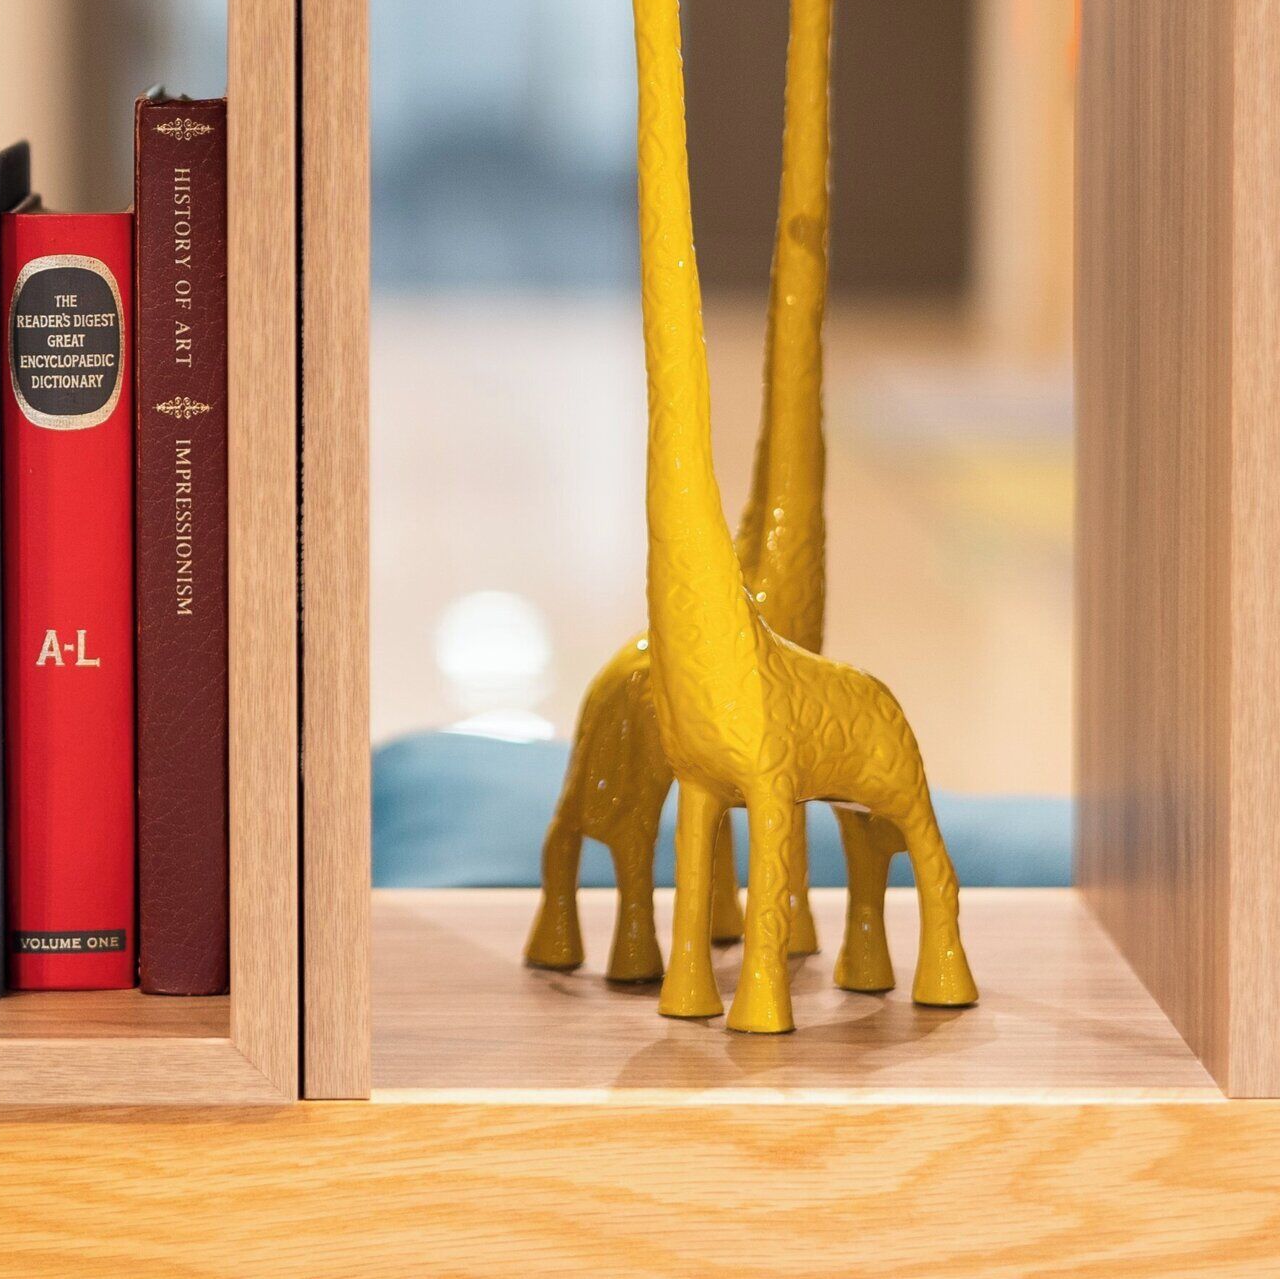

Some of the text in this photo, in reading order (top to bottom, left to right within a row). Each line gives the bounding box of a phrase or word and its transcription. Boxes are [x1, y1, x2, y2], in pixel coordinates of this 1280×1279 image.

[174, 168, 193, 368] HISTORY OF ART
[54, 295, 78, 308] THE
[16, 312, 116, 328] READER'S DIGEST
[47, 334, 86, 348] GREAT
[20, 353, 115, 369] ENCYCLOPAEDIC
[31, 374, 104, 389] DICTIONARY
[175, 439, 193, 616] IMPRESSIONISM
[35, 628, 101, 667] A-L
[21, 936, 120, 950] VOLUME ONE
